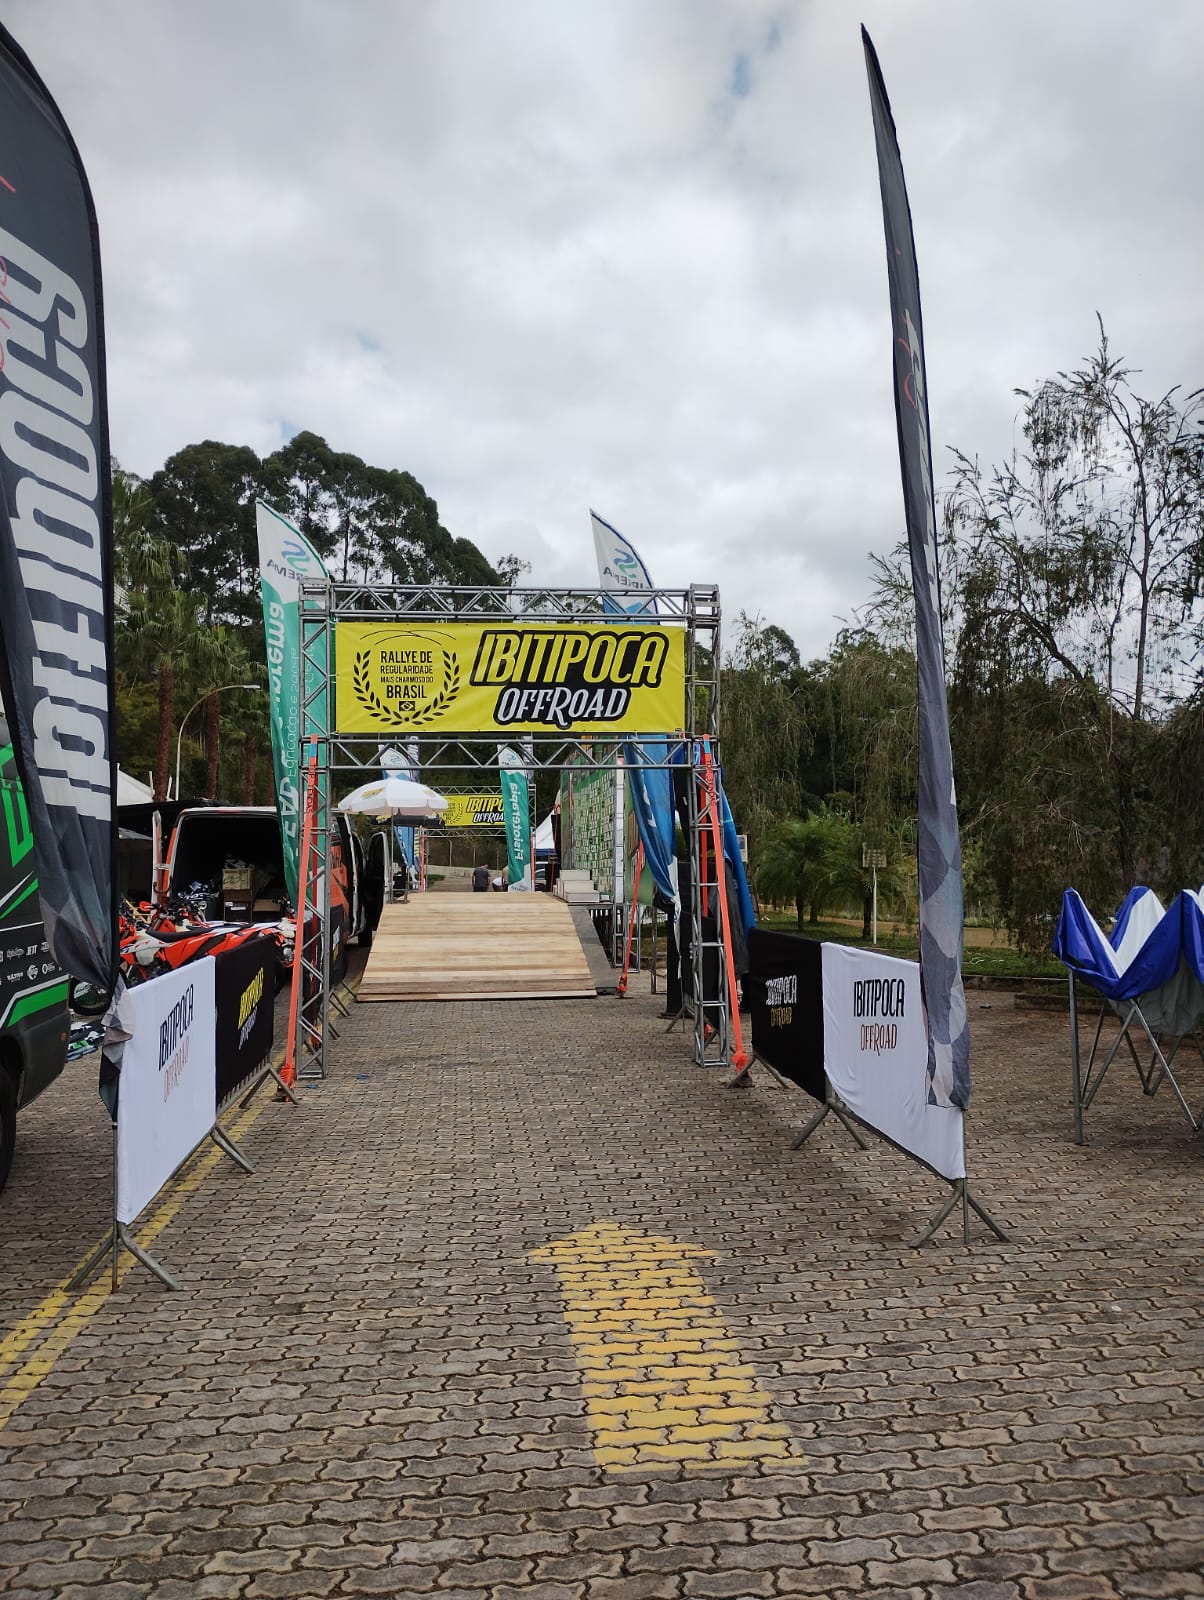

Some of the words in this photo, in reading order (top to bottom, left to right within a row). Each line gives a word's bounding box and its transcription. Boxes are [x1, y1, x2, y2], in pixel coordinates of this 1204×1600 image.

[380, 650, 418, 664] RALLYE
[420, 650, 433, 664] DE
[380, 665, 433, 675] REGULARIDADE
[473, 632, 667, 685] IBITIPOCA
[380, 676, 394, 684] MAIS
[386, 684, 428, 699] BRASIL
[497, 687, 627, 728] OFFROAD
[853, 978, 905, 1017] IBITIPOCA
[158, 983, 194, 1072] IBITIPOCA
[860, 1023, 898, 1056] OFFROAD
